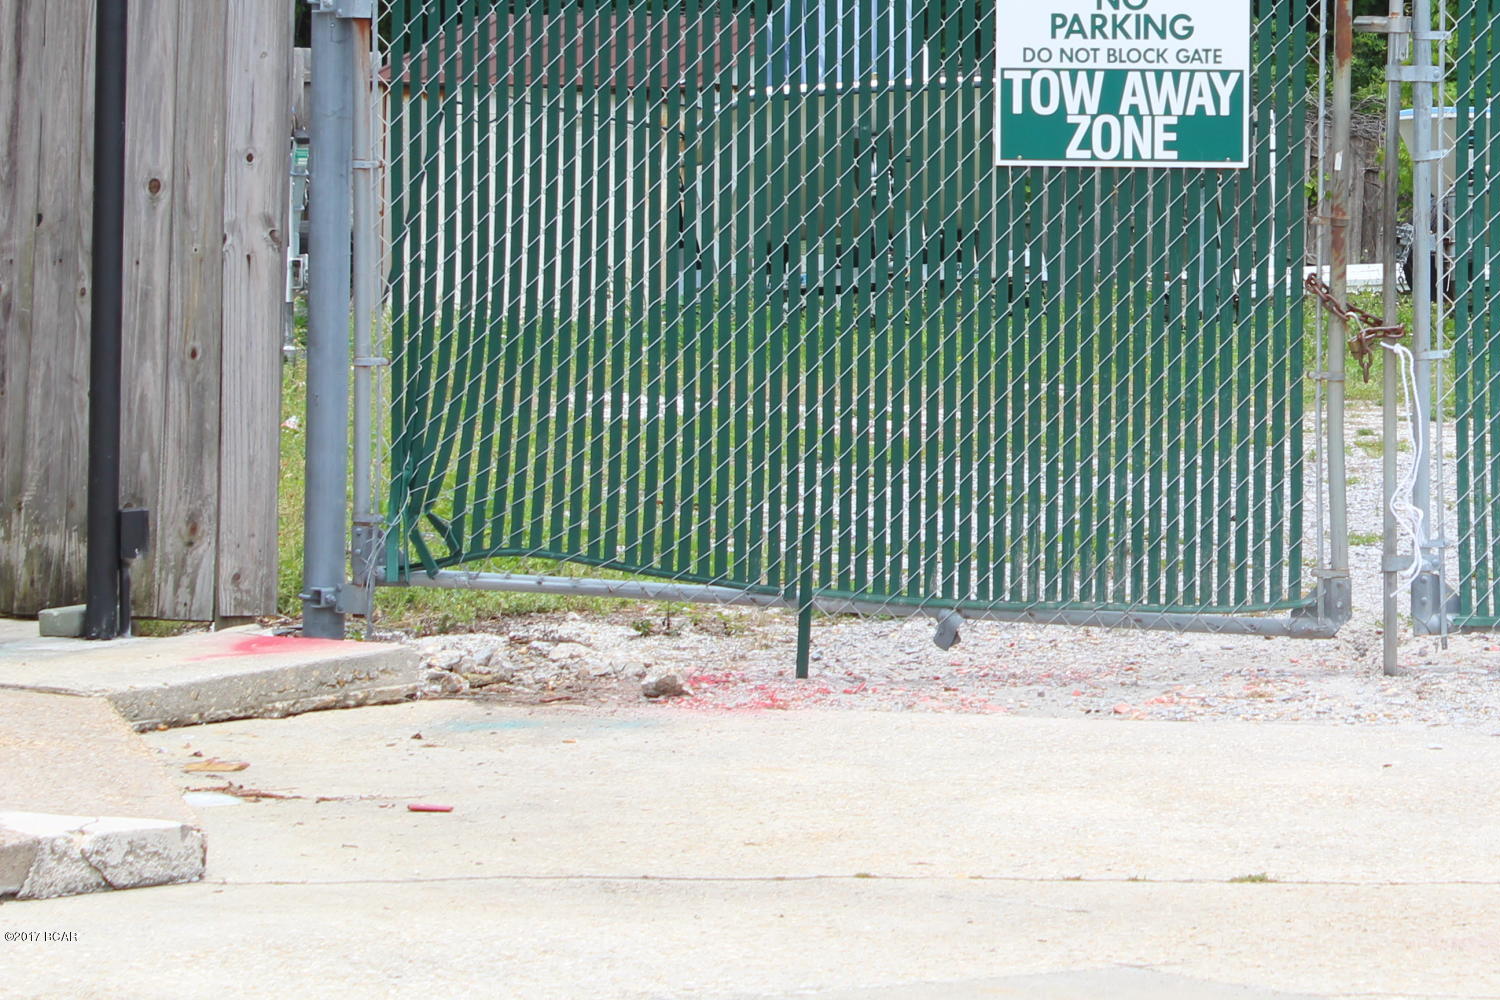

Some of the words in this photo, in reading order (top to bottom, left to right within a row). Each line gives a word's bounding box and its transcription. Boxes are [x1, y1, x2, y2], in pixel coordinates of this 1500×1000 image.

[1050, 13, 1195, 40] PARKING
[1022, 47, 1053, 63] DO
[1059, 47, 1100, 64] NOT
[1106, 48, 1169, 64] BLOCK
[1175, 48, 1223, 64] GATE
[1003, 69, 1105, 116] TOW
[1118, 70, 1241, 117] AWAY
[1065, 113, 1179, 161] ZONE
